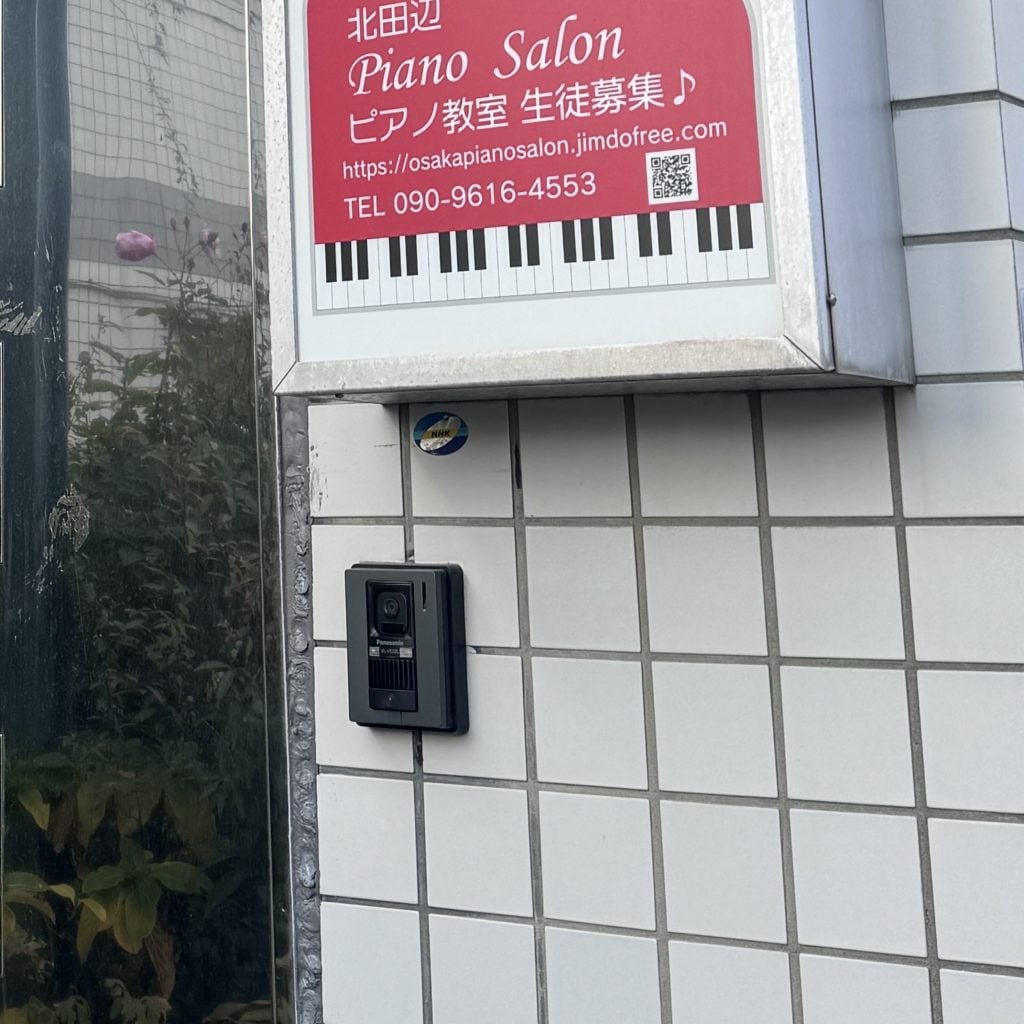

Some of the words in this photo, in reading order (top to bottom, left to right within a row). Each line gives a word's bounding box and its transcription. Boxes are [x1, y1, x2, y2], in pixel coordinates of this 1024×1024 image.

[348, 48, 468, 96] Piano
[494, 14, 625, 80] Salon
[350, 93, 508, 144] ピアノ教室
[343, 121, 727, 179] https://osakapianosalon.jimdofree.com
[344, 192, 386, 219] TEL
[394, 172, 596, 215] 090-9616-4553
[431, 429, 450, 438] NHK
